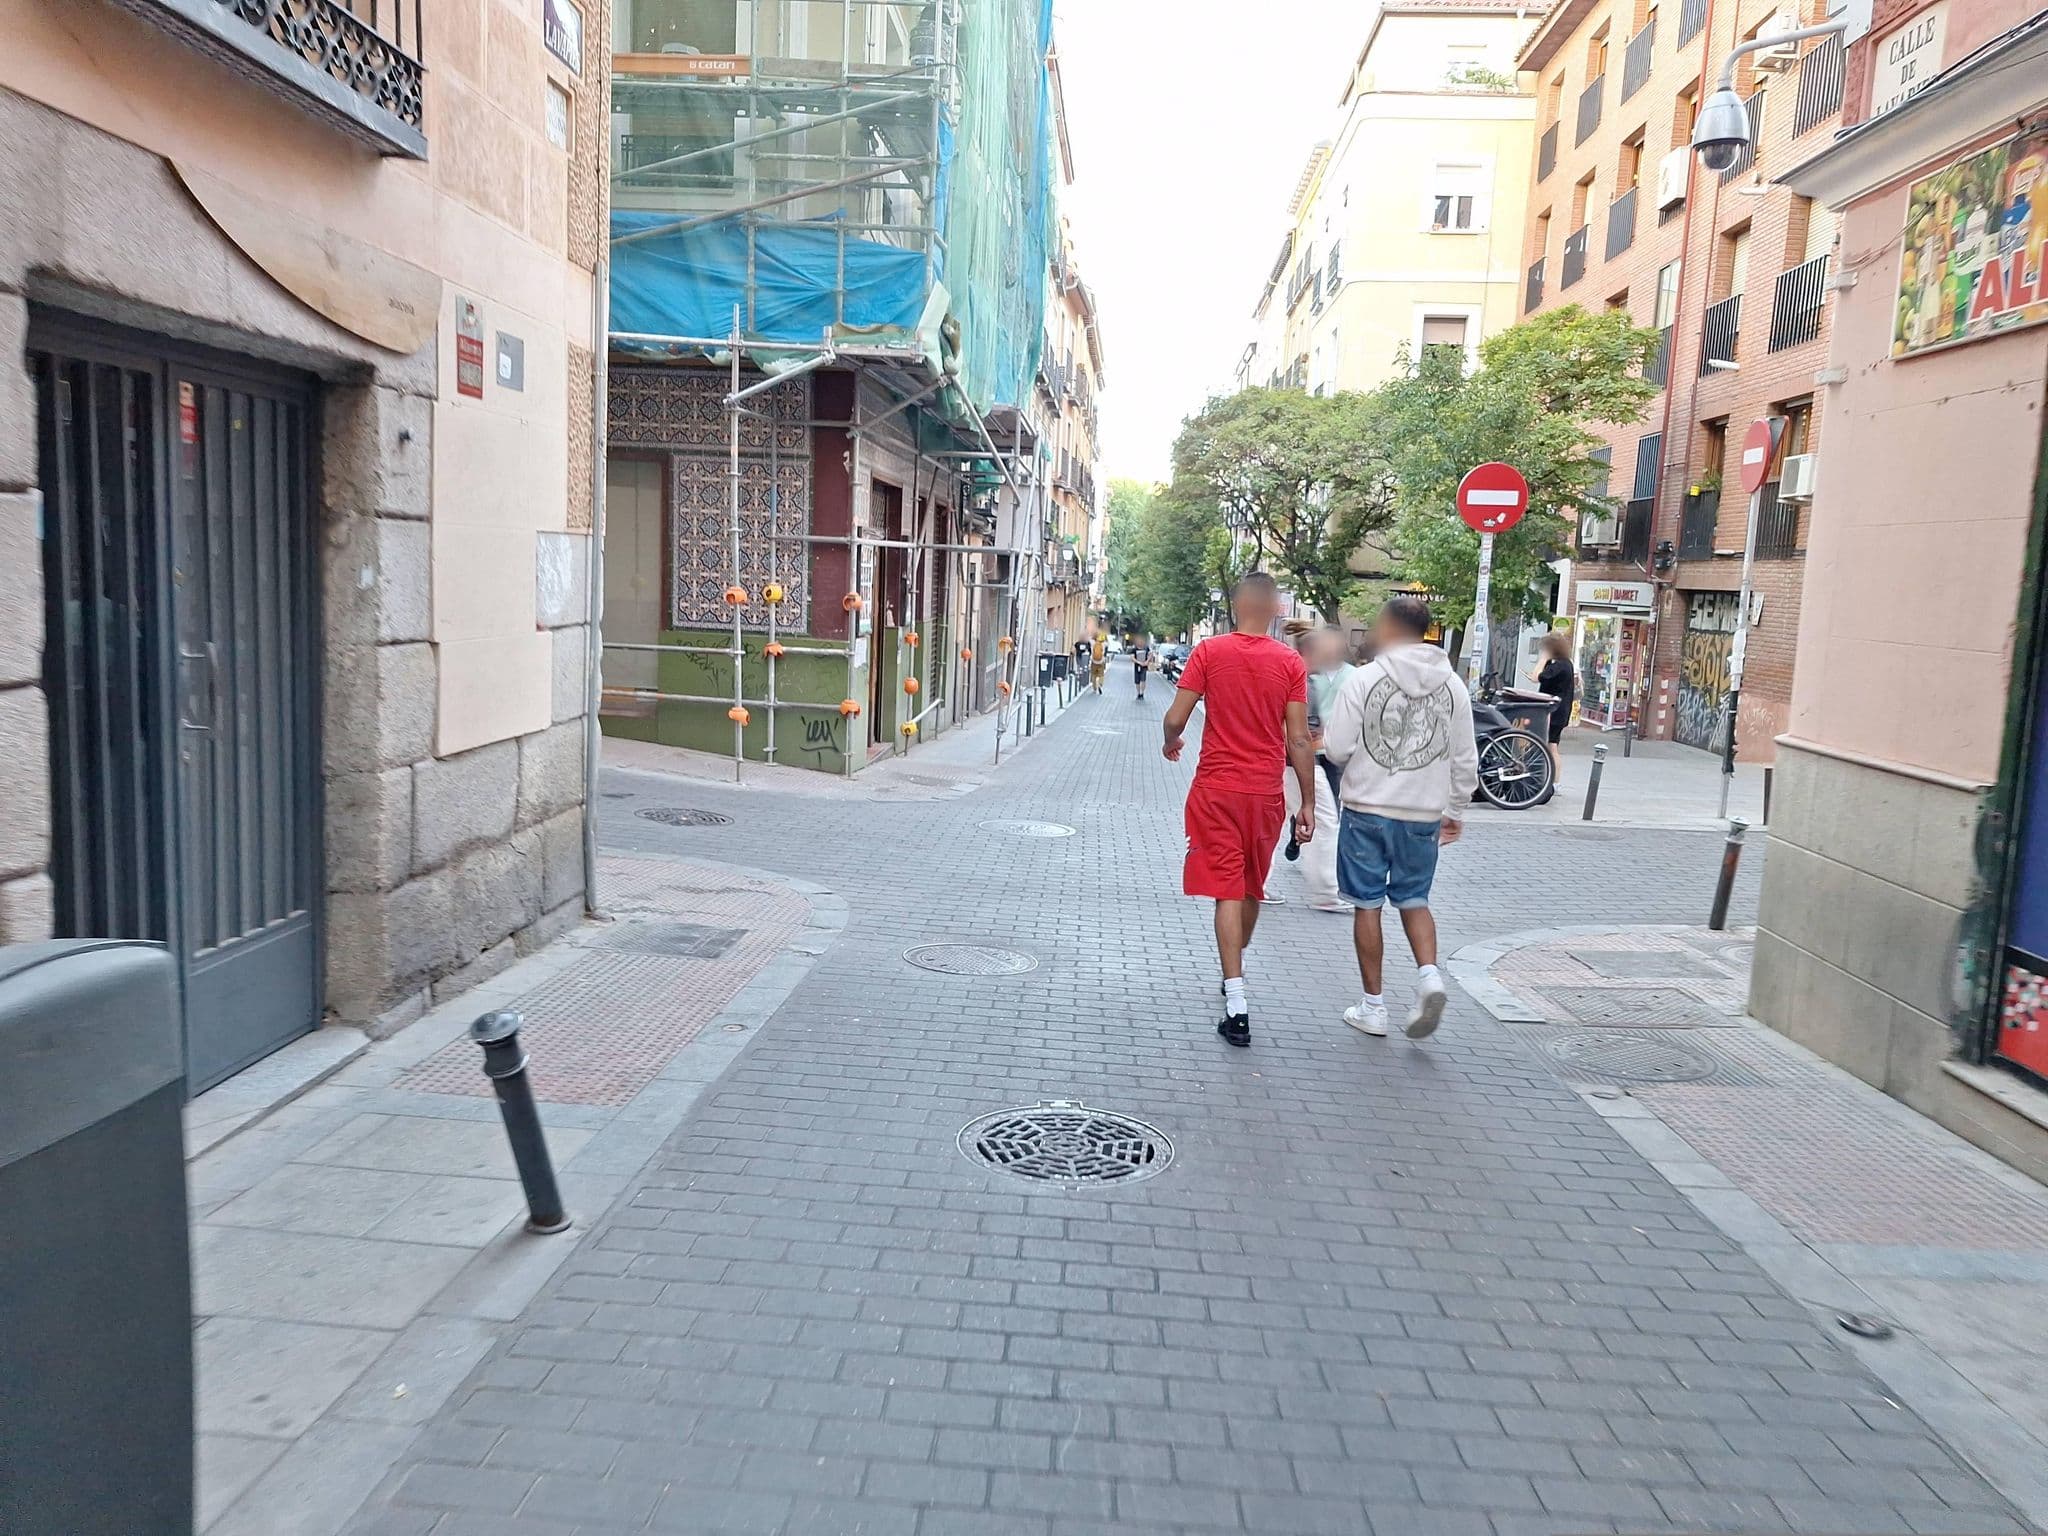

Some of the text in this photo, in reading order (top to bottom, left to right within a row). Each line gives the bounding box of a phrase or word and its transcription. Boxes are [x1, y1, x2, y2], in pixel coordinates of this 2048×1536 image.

[1889, 15, 1936, 66] CALLE
[1900, 58, 1918, 86] DE
[1613, 589, 1639, 601] MARKET
